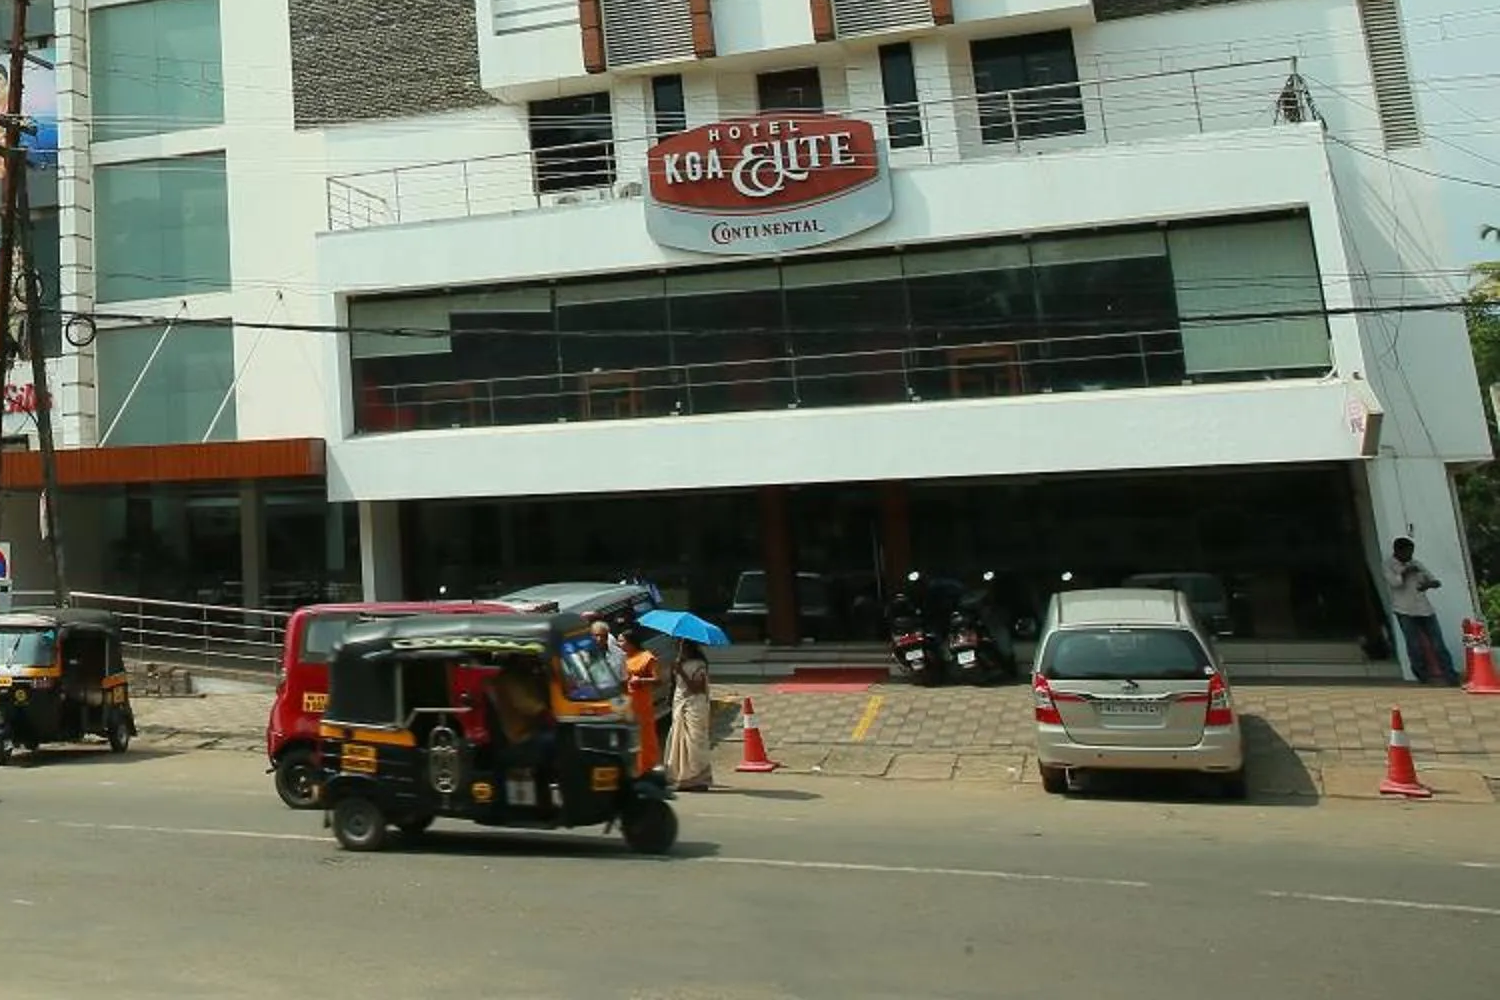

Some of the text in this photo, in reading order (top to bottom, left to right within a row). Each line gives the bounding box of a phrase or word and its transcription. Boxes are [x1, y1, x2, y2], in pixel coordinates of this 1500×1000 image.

[707, 119, 801, 143] HOTEL
[663, 131, 856, 198] KGA ELITE
